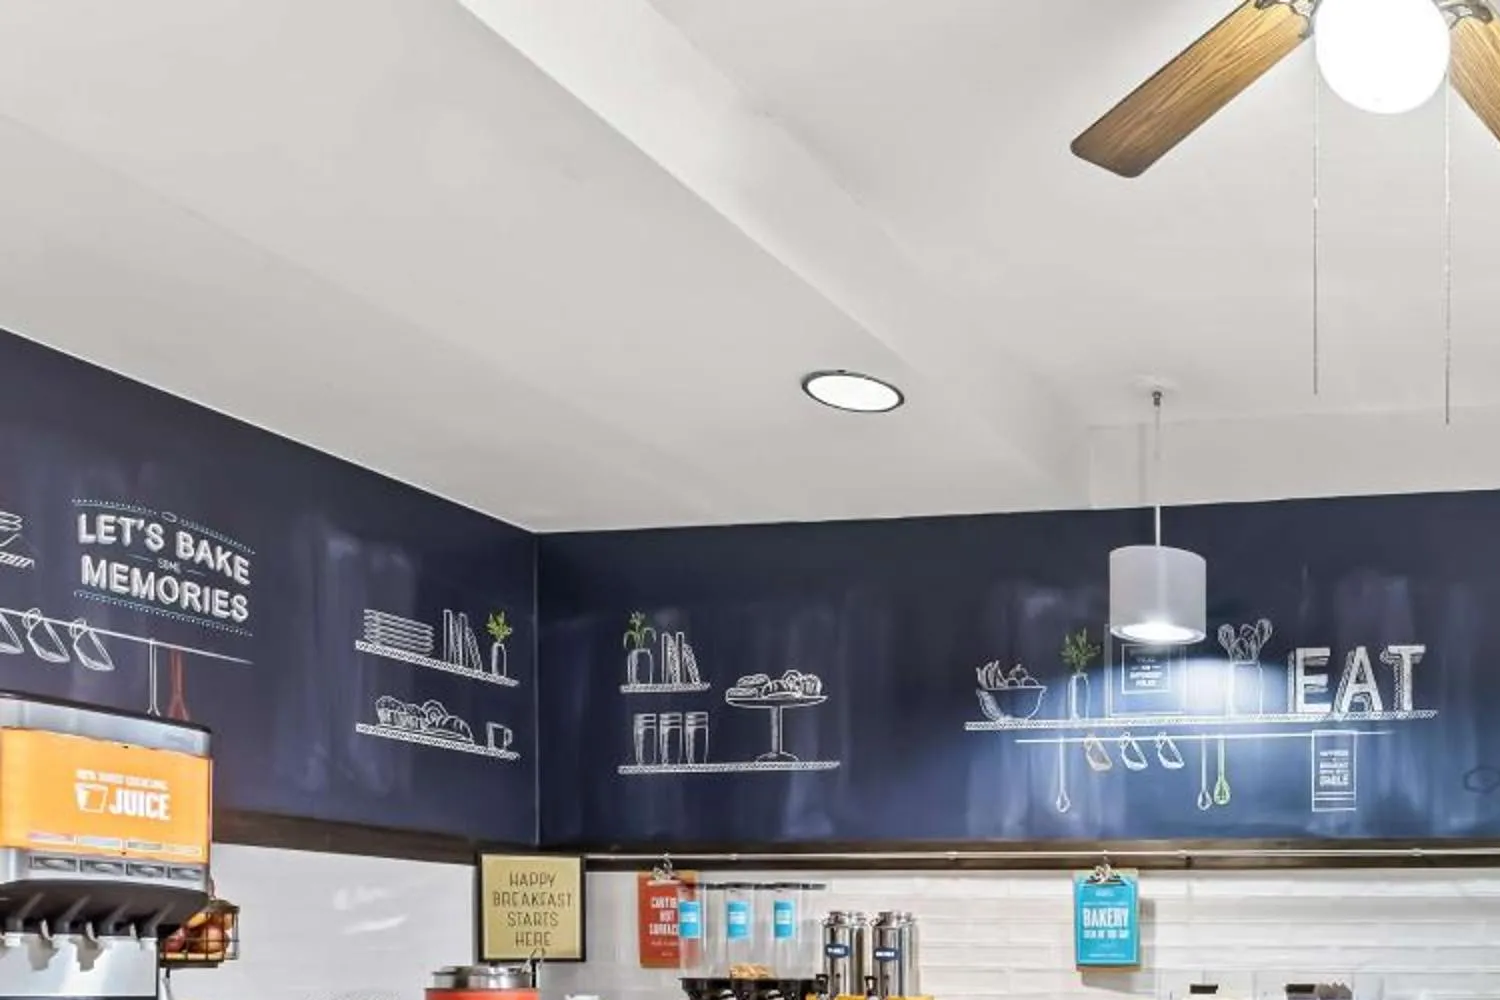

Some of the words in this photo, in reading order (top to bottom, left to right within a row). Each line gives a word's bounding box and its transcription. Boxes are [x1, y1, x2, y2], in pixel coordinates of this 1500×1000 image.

[77, 513, 165, 551] LET'S
[175, 530, 251, 586] BAKE
[81, 555, 249, 623] MEMORIES
[1287, 643, 1427, 716] EAT
[109, 787, 171, 821] JUICE
[509, 871, 558, 888] HAPPY
[492, 891, 571, 908] BREAKFAST
[507, 911, 559, 928] STARTS
[1083, 907, 1129, 928] BAKERY
[649, 923, 678, 936] SURFAC
[515, 931, 552, 948] HERE
